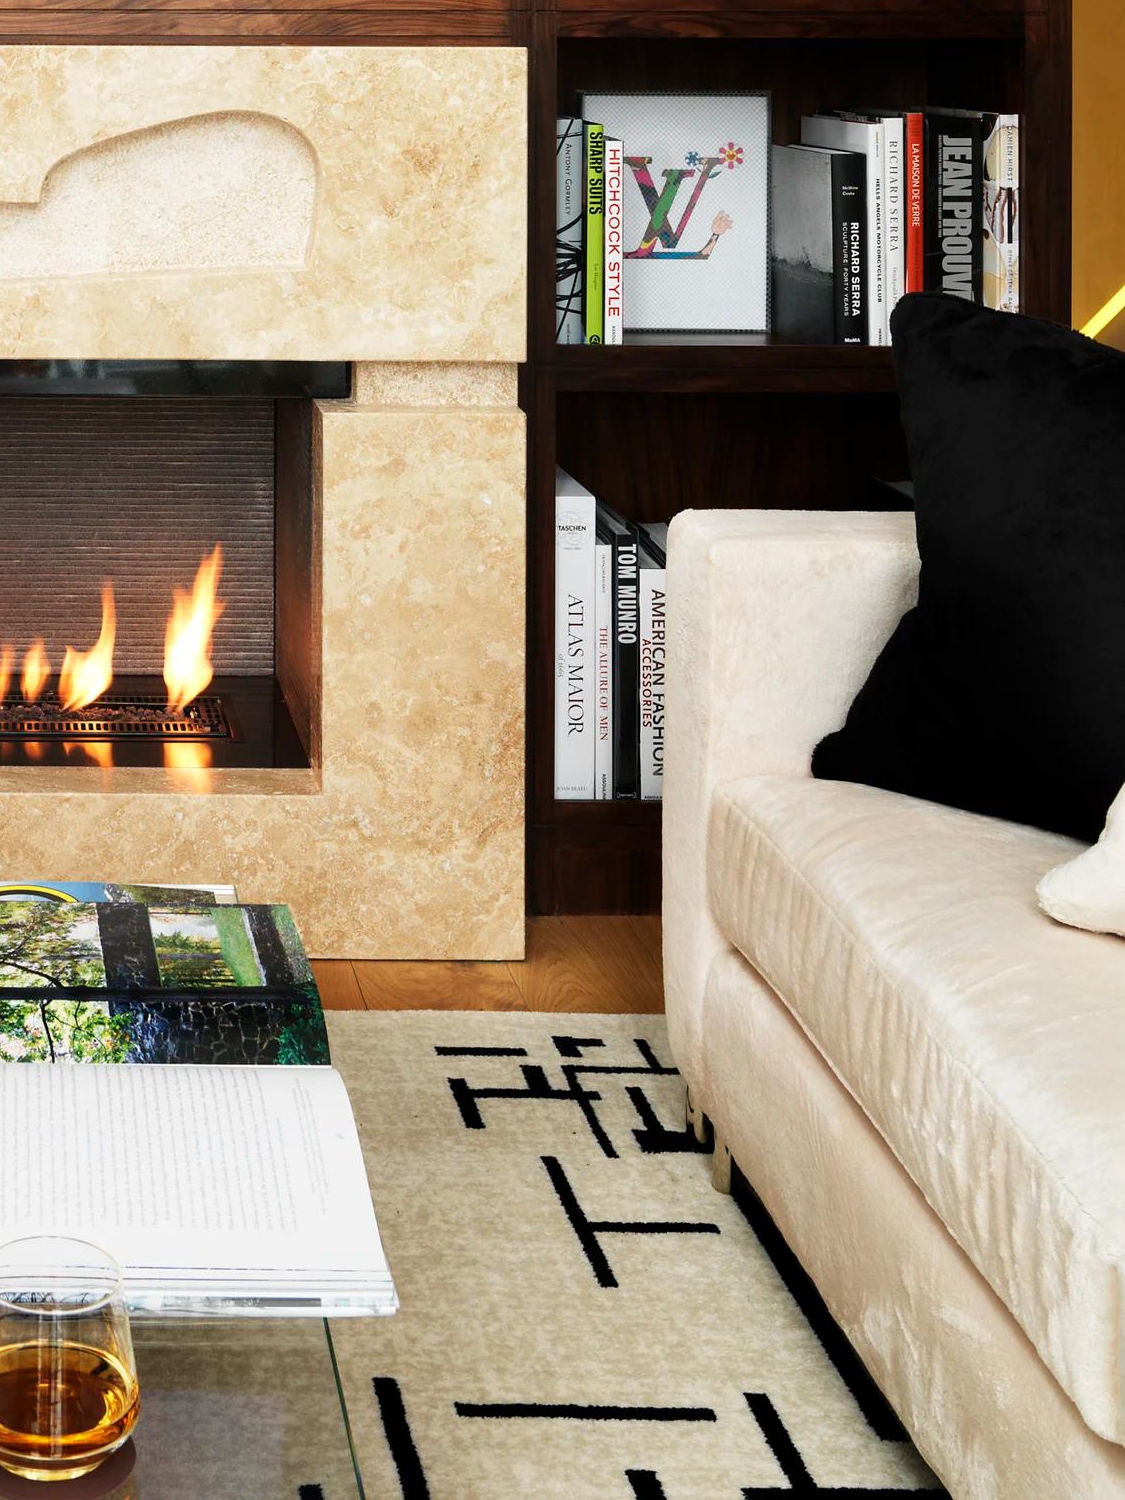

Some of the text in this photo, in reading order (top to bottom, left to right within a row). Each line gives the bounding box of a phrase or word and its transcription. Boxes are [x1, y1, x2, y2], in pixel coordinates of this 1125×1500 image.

[589, 132, 604, 215] SHARP SUITS
[888, 141, 898, 252] RICHARD SERRA
[911, 143, 920, 226] LA MAISON DE VERRE
[942, 135, 972, 196] JEAN
[608, 149, 620, 316] HITCHCOCK STYLE
[851, 222, 860, 316] RICHARD SERRA
[618, 544, 637, 644] TOM MUNRO
[567, 594, 584, 736] ATLAS MAIOR
[642, 638, 652, 728] ACCESSORIES
[651, 589, 666, 776] AMERICAN FASHION
